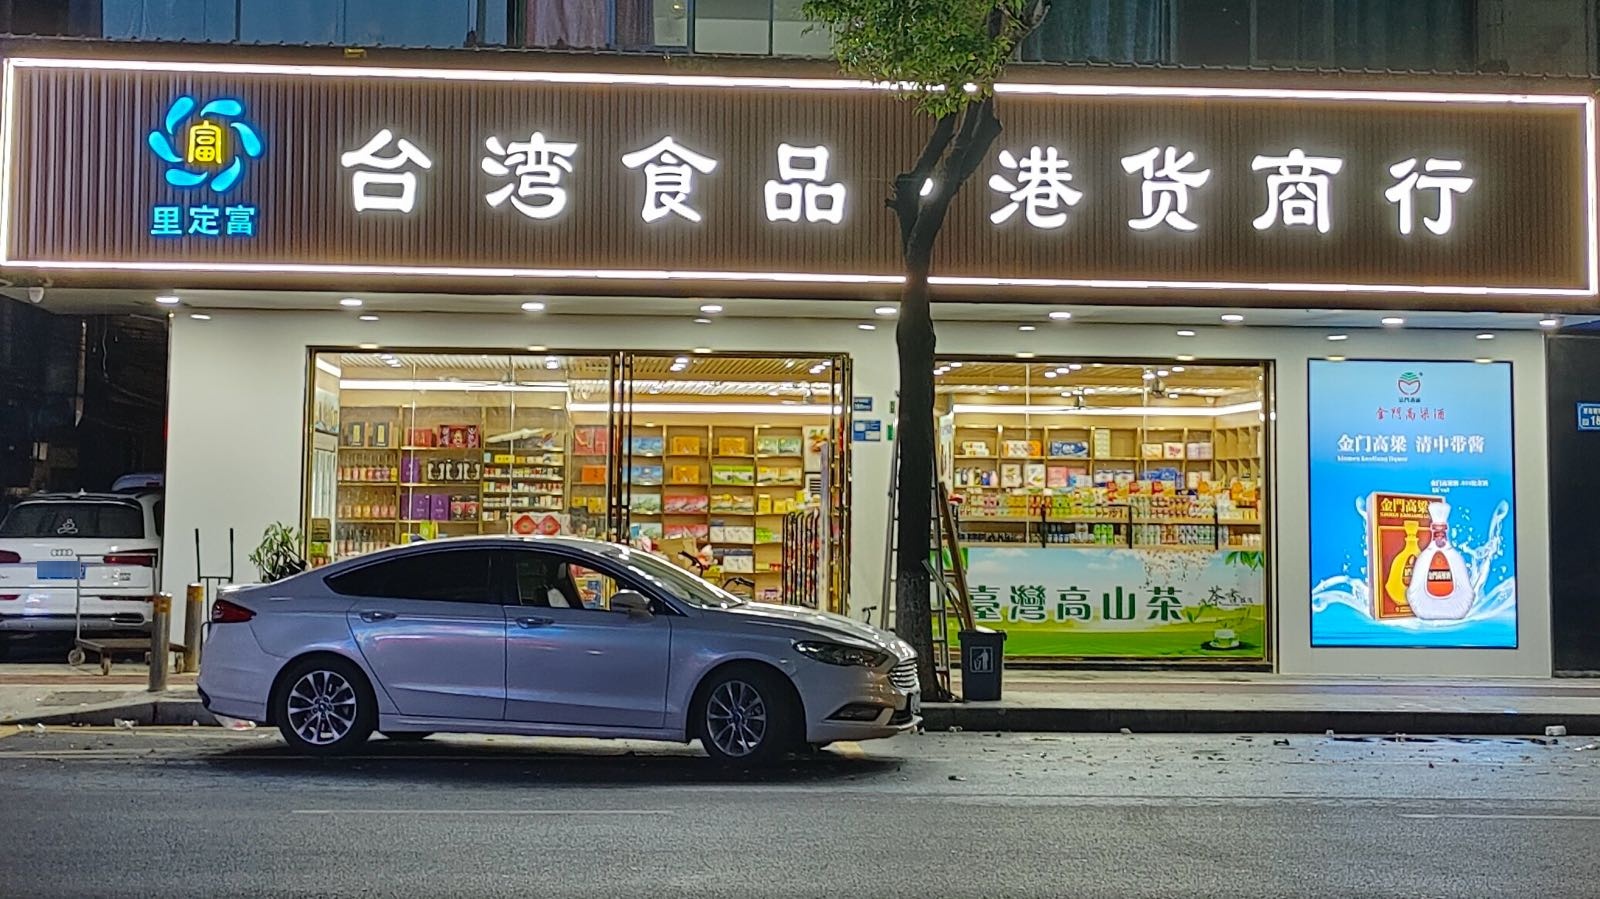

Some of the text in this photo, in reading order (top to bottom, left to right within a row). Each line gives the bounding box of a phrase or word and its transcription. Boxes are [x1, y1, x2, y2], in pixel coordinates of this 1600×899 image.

[188, 120, 222, 164] 富
[150, 204, 256, 237] 里定富
[969, 585, 1183, 622] 臺灣高山茶
